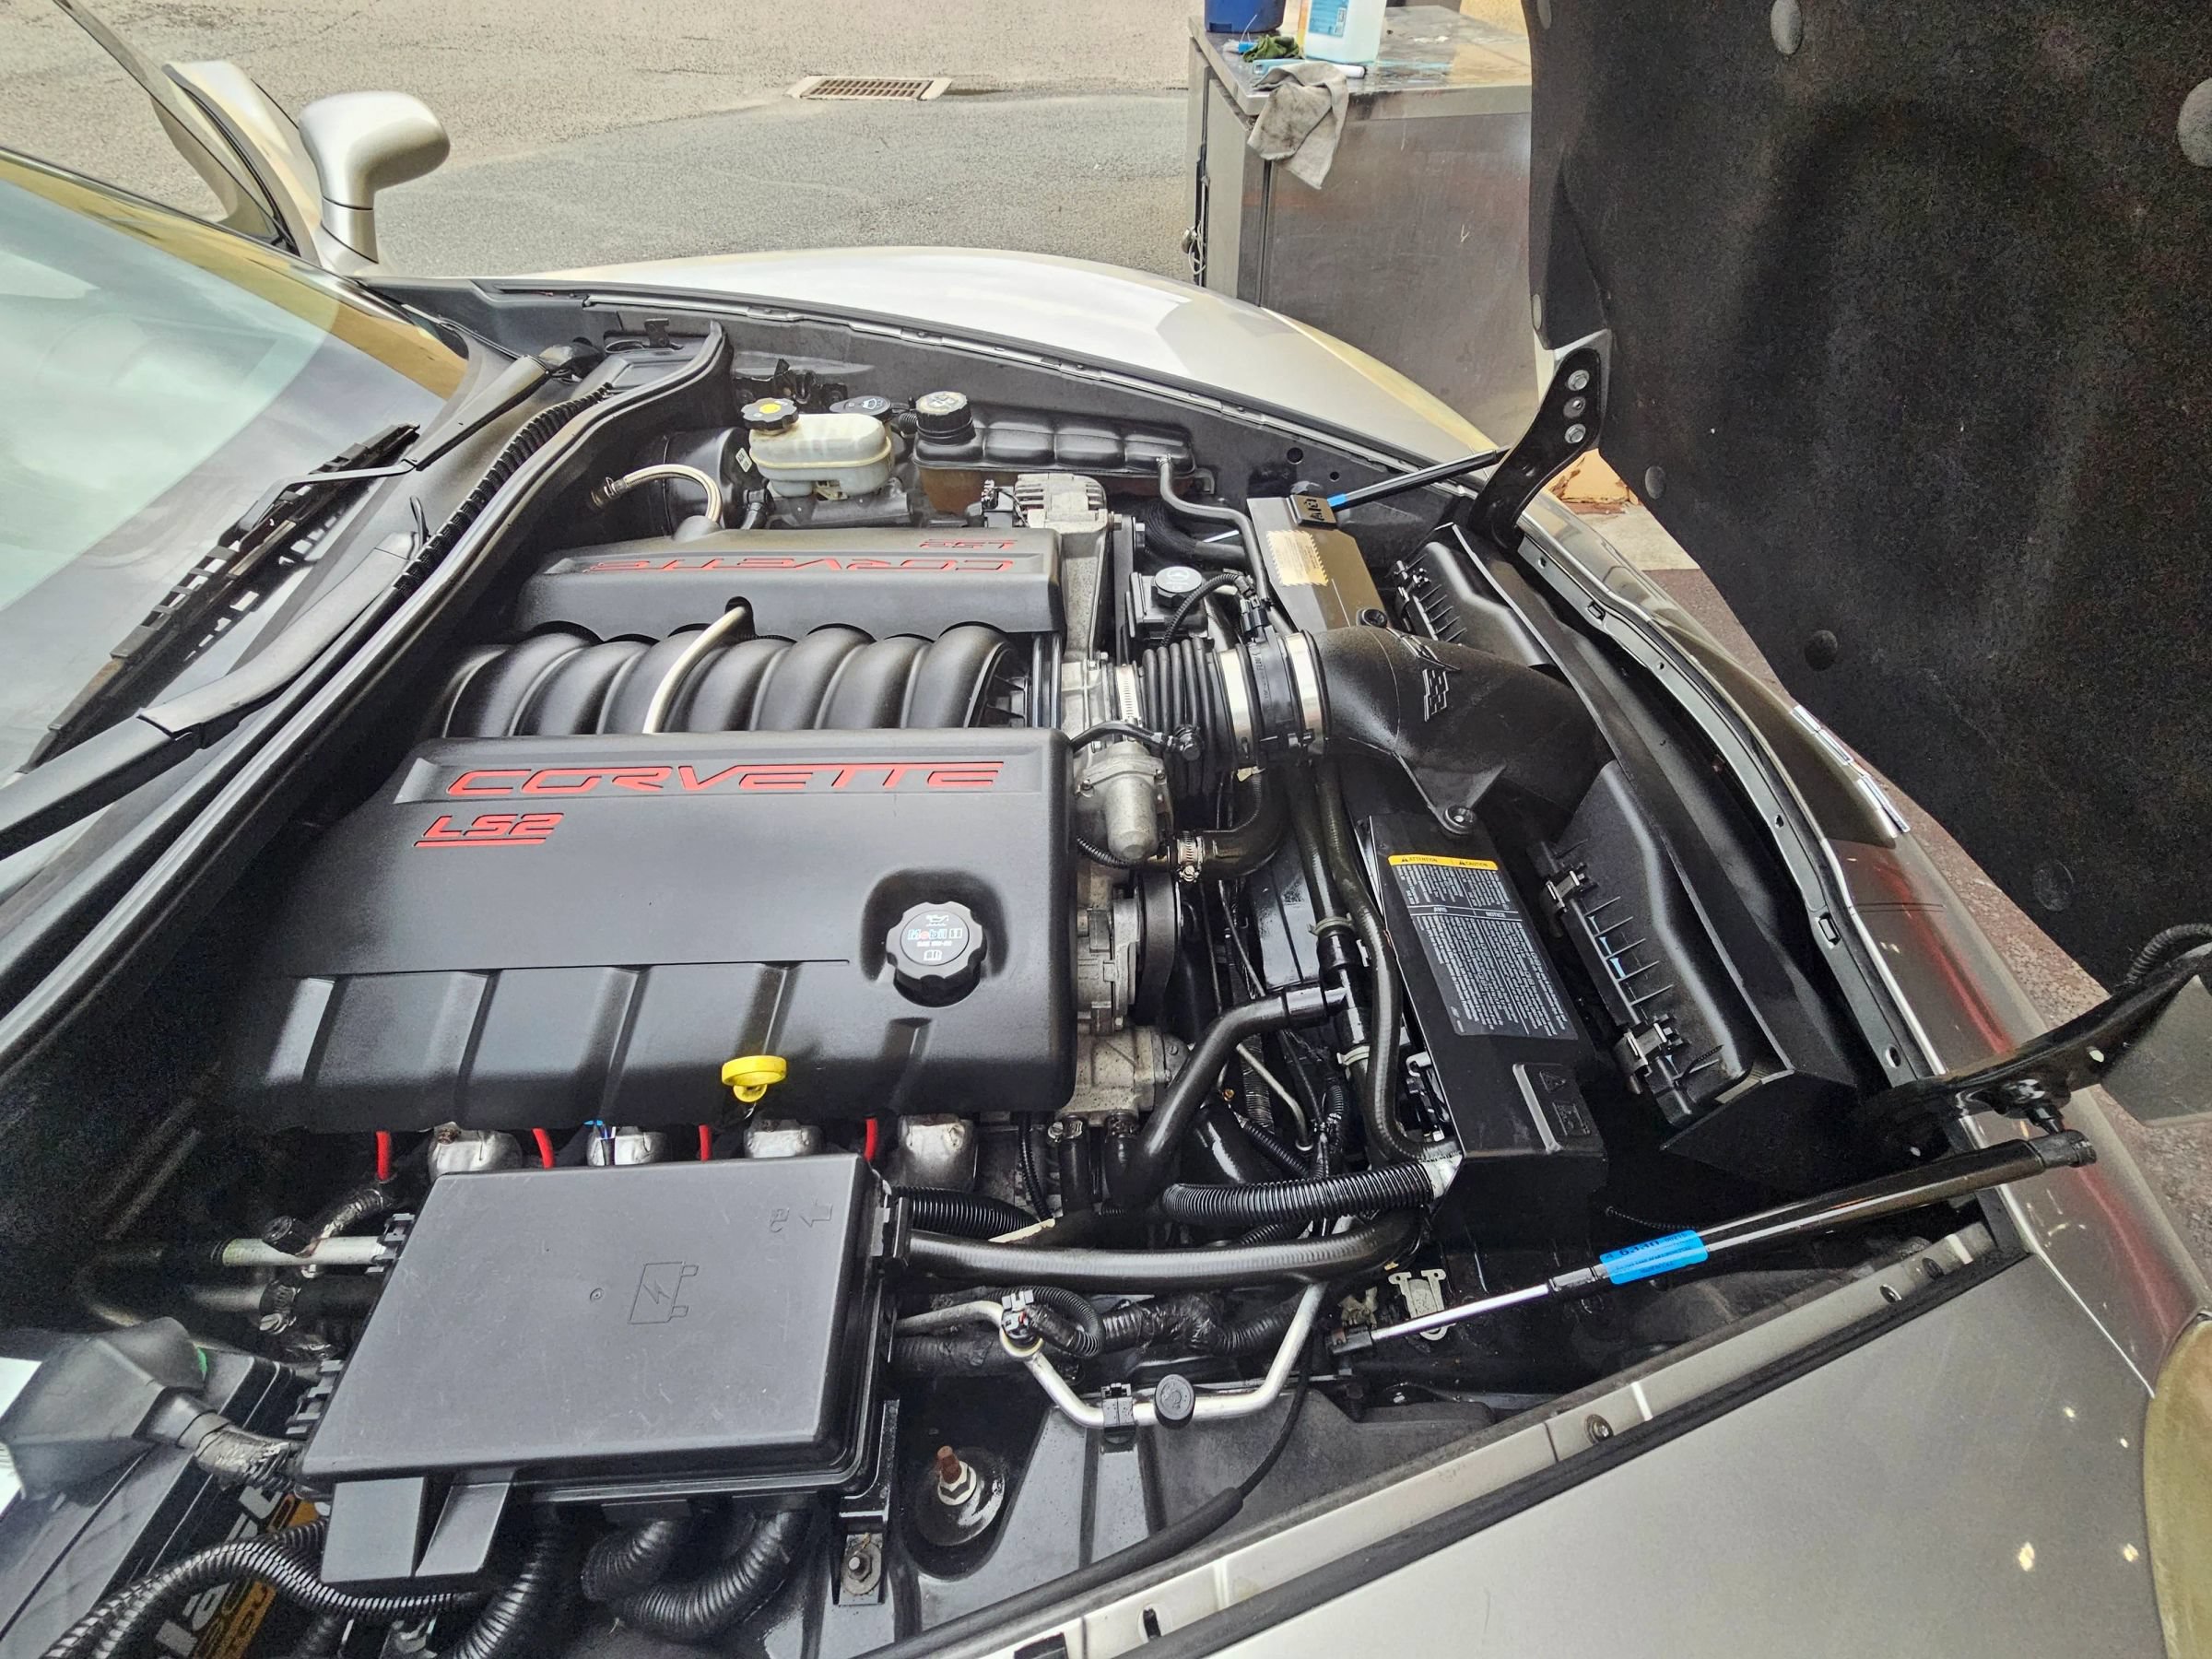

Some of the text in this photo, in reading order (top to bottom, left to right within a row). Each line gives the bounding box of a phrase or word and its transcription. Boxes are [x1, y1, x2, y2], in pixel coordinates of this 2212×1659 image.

[582, 557, 1014, 573] CORVETTE
[447, 761, 1005, 795] CORVETTE
[422, 812, 564, 838] LS2
